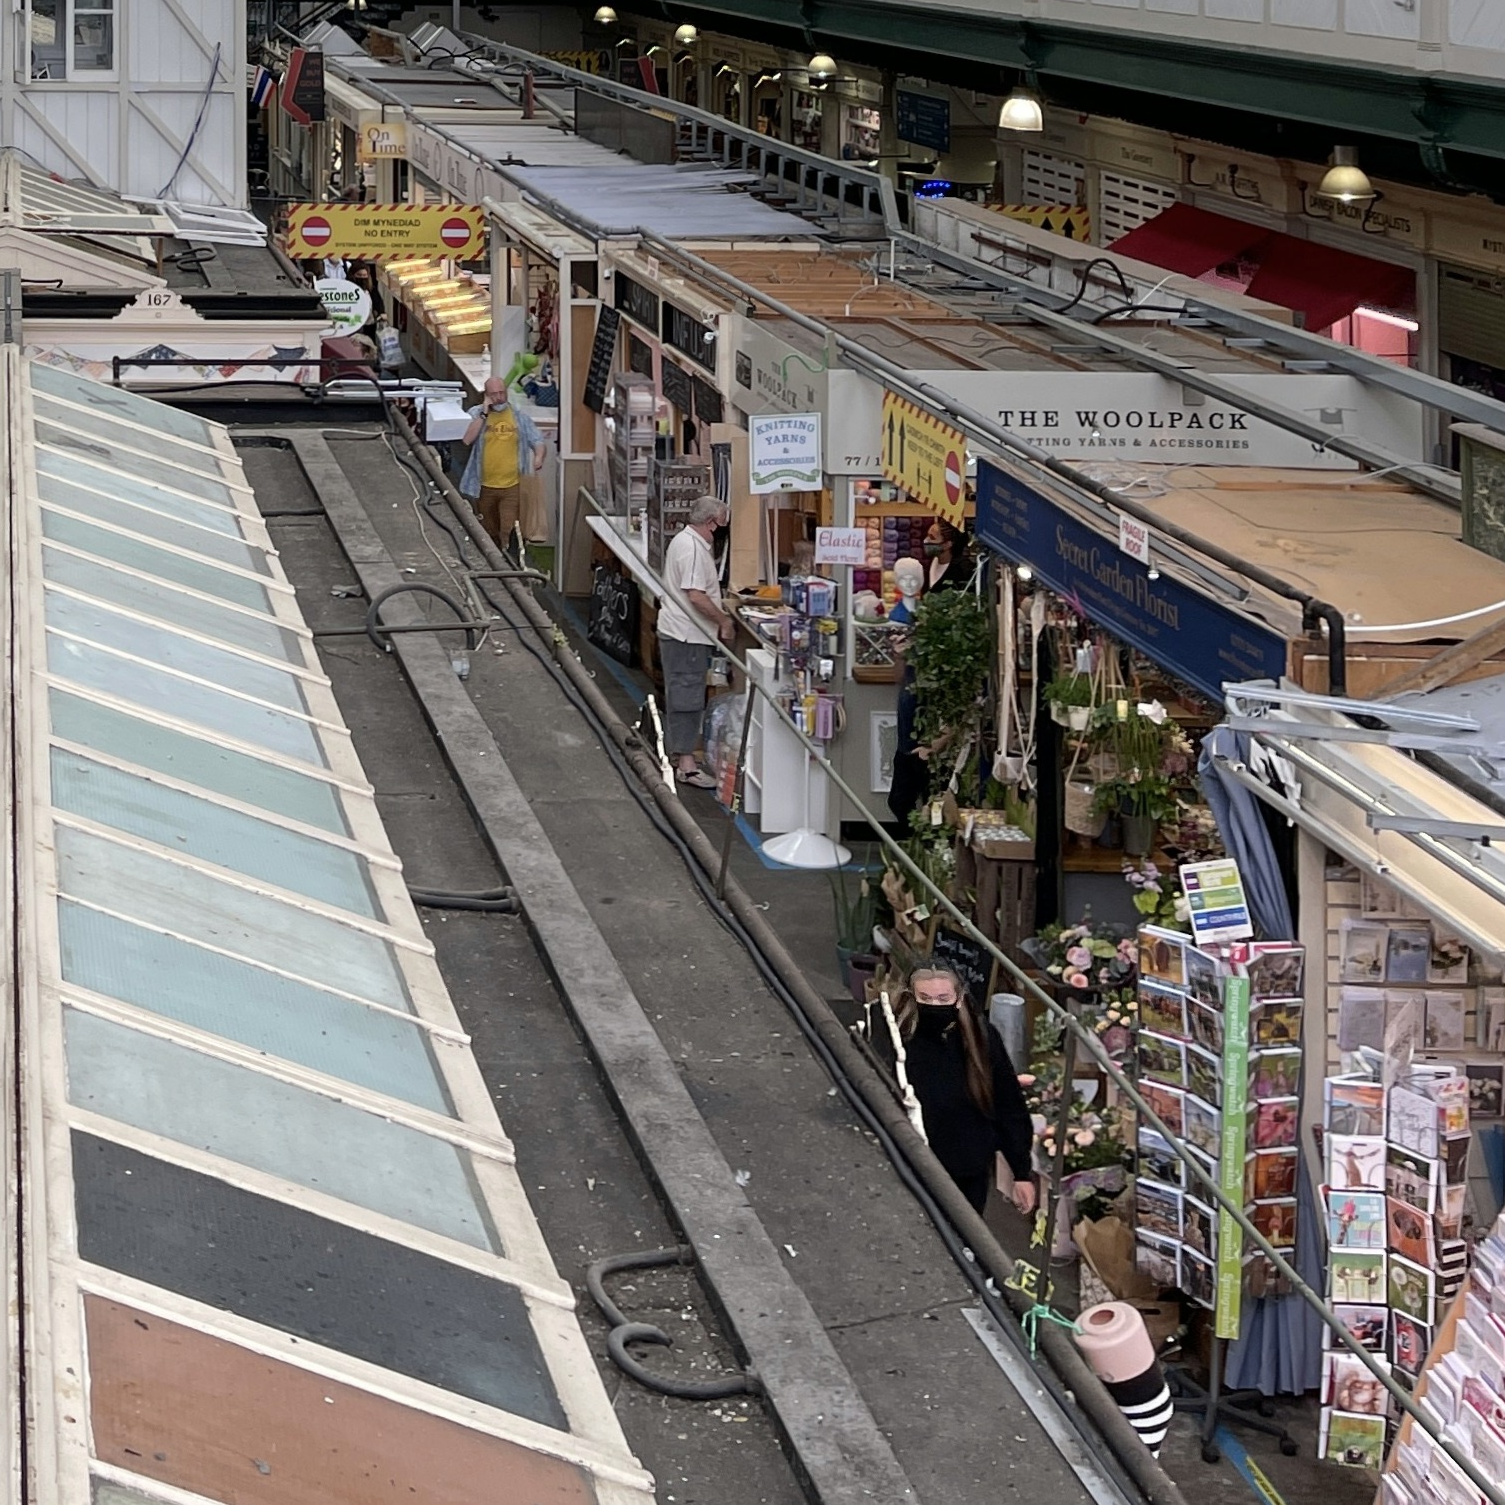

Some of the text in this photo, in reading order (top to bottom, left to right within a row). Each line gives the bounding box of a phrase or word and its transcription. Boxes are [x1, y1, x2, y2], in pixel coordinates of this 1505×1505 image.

[299, 79, 321, 88] GOLD
[367, 127, 390, 143] On
[370, 141, 406, 153] Time
[354, 219, 421, 227] DIM MYNEDIAD
[364, 230, 410, 238] NO ENTRY
[147, 293, 170, 306] 167
[757, 368, 797, 409] WOOLPACK
[756, 420, 815, 435] KNITTING
[999, 411, 1248, 429] THE WOOLPACK
[765, 434, 806, 445] YARNS
[1079, 438, 1126, 447] YARNS
[1133, 438, 1142, 447] &
[1149, 438, 1249, 449] ACCESSORIES
[757, 456, 816, 466] ACCESSORIES
[845, 456, 862, 466] 77
[819, 530, 864, 548] Elastic
[1122, 519, 1145, 544] FRAGILE
[1125, 536, 1143, 557] ROOF
[1056, 524, 1089, 575] Secret
[1090, 546, 1134, 602] Garden
[1135, 571, 1181, 632] Florist
[1229, 979, 1242, 1044] Springwatch
[1228, 1052, 1240, 1116] Springwatch
[1226, 1125, 1238, 1190] Springwatch
[1221, 1272, 1234, 1337] Springwatch
